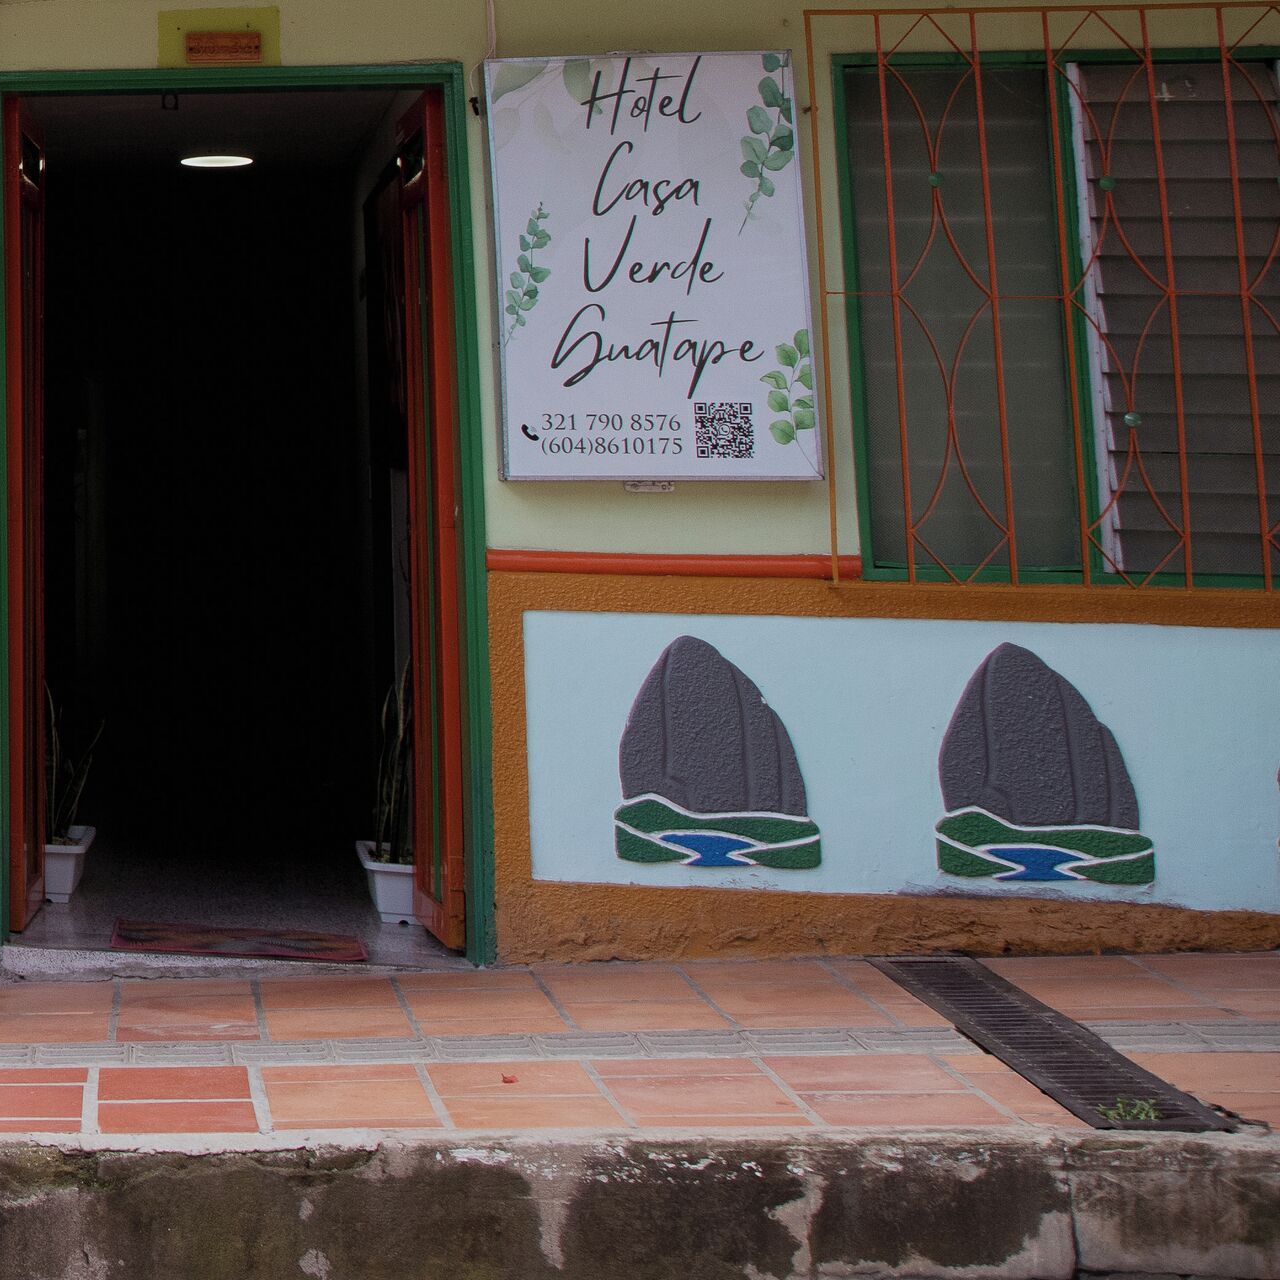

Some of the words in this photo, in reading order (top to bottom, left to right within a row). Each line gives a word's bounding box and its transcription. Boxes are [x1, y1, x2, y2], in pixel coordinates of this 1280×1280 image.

[581, 56, 702, 135] Hotel
[592, 141, 700, 216] Casa
[584, 215, 724, 295] Verde
[551, 304, 764, 399] Guatape
[541, 437, 683, 455] (604)8610175
[542, 414, 577, 431] 321
[586, 414, 623, 431] 790
[630, 414, 681, 431] 8576
